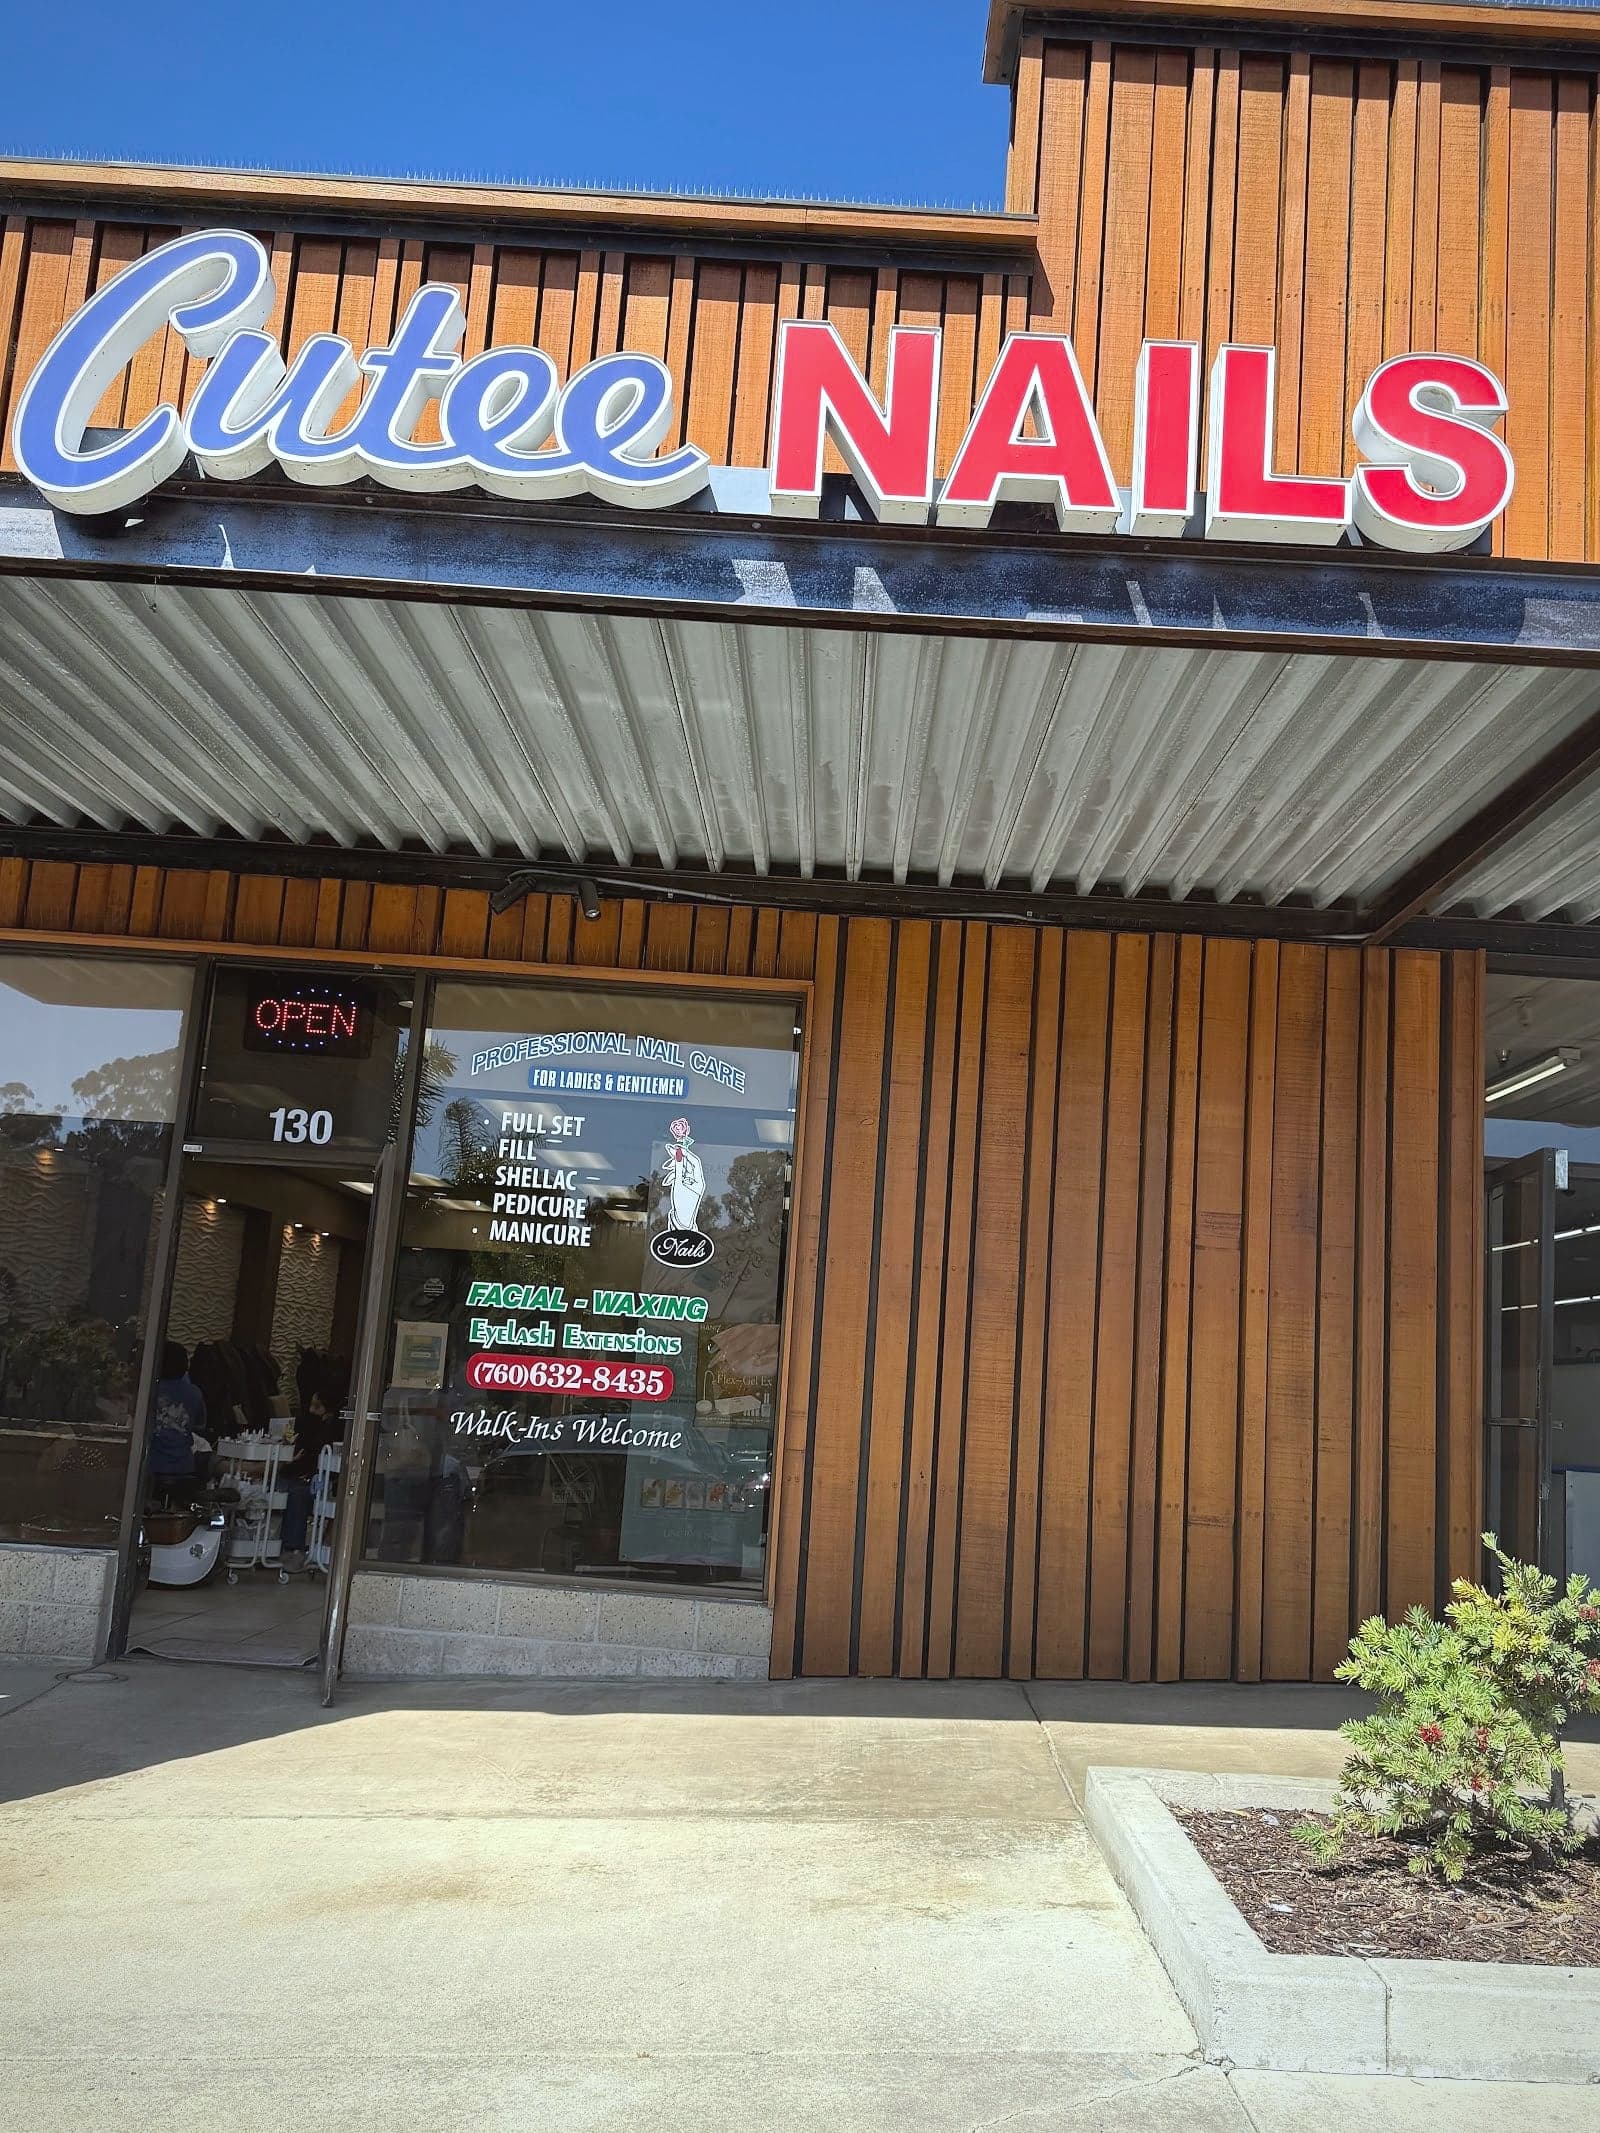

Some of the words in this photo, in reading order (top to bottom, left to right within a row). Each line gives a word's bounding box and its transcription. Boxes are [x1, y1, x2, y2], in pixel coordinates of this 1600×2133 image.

[12, 228, 711, 500] Cutee
[768, 318, 1516, 534] NAILS
[255, 999, 357, 1036] OPEN
[471, 1031, 630, 1075] PROFESSIONAL
[635, 1035, 684, 1067] NAIL
[689, 1050, 745, 1094] CARE
[533, 1069, 556, 1088] FOR
[559, 1070, 601, 1091] LADIES
[605, 1072, 613, 1091] &
[616, 1074, 684, 1096] GENTLEMEN
[269, 1107, 333, 1145] 130
[501, 1111, 546, 1134] FULL
[550, 1115, 585, 1136] SET
[498, 1139, 537, 1161] FILL
[494, 1165, 577, 1191] SHELLAC
[492, 1193, 587, 1219] PEDICURE
[489, 1220, 592, 1247] MANICURE
[657, 1237, 706, 1257] Nails
[465, 1281, 568, 1312] FACIAL
[592, 1289, 709, 1323] WAXING
[474, 1361, 664, 1396] (760)632-8435
[450, 1409, 564, 1443] Walk-Ins
[572, 1412, 682, 1449] Welcome
